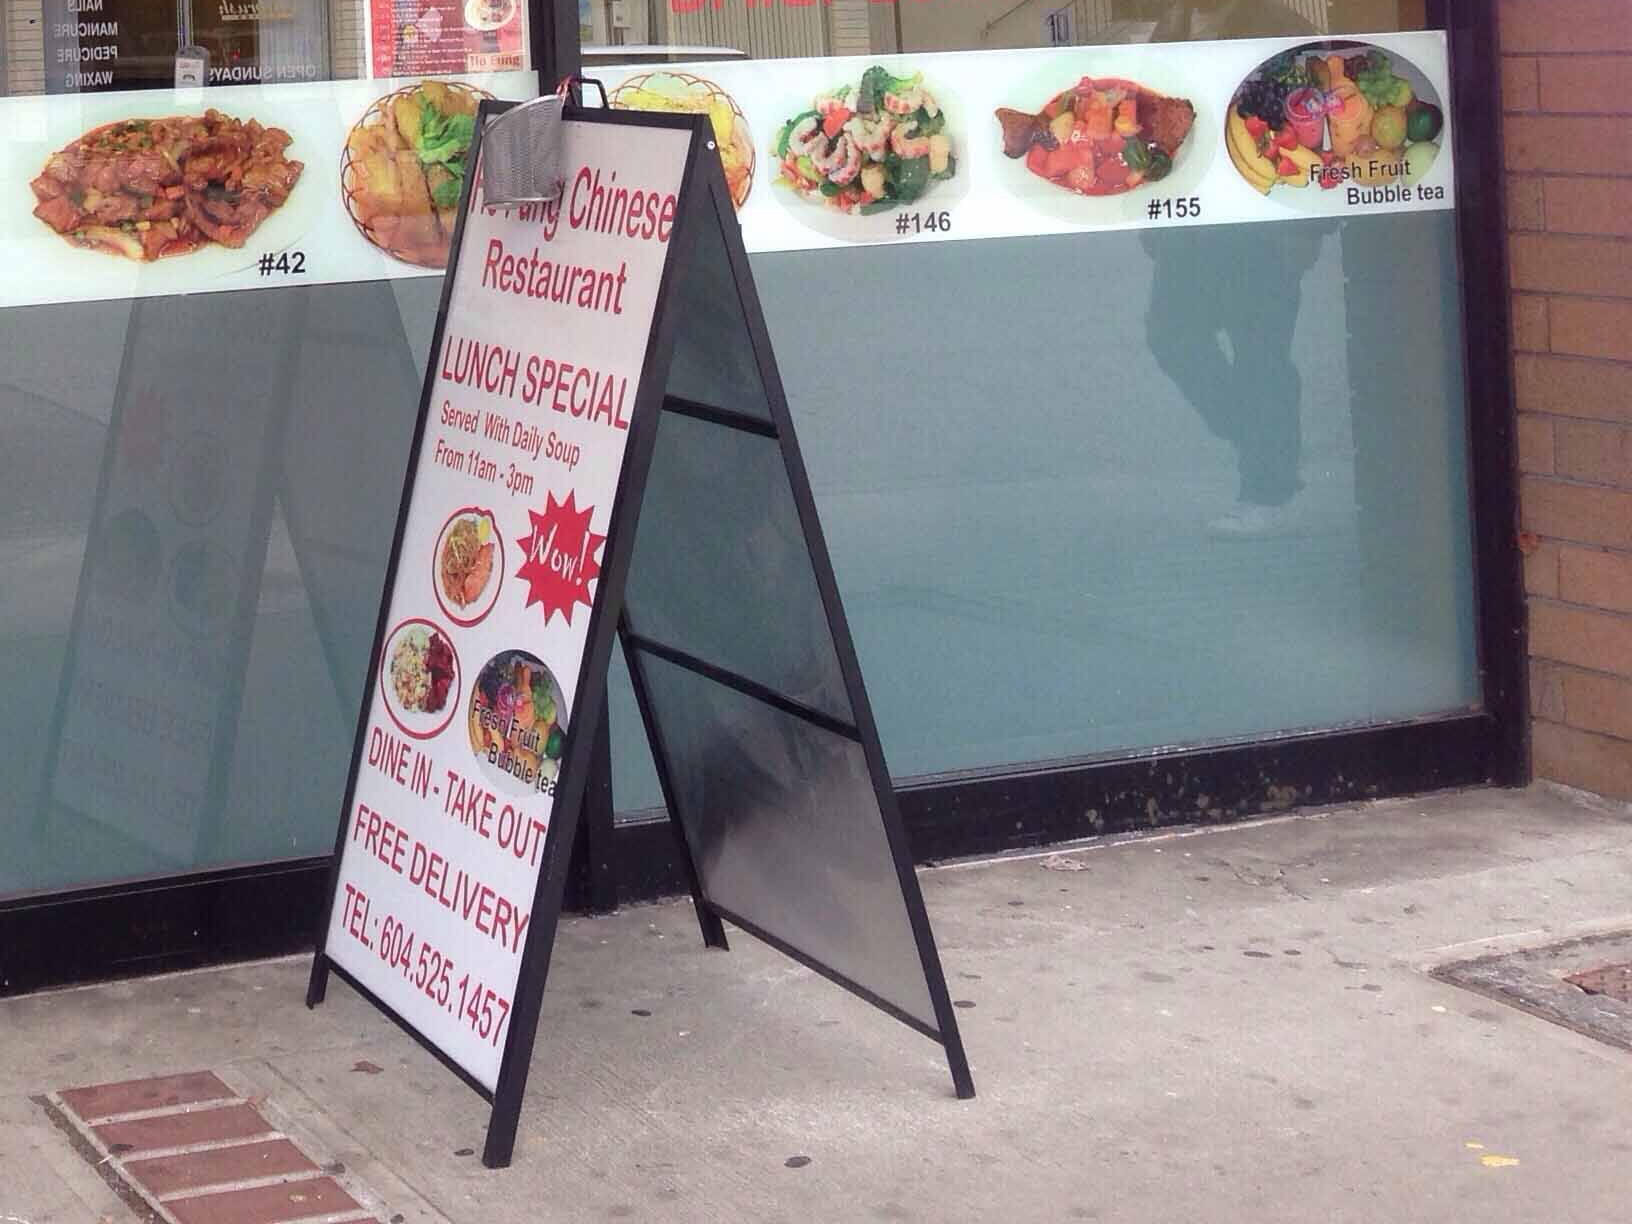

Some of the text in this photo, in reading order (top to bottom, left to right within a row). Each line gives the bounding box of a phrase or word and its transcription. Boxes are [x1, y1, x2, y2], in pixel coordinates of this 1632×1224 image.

[1310, 158, 1412, 181] Fresh Fruit
[1346, 184, 1446, 207] Bubble tea
[570, 166, 677, 243] Chinese
[895, 211, 952, 235] #146
[1147, 197, 1202, 221] #155
[258, 251, 306, 277] #42
[481, 239, 627, 314] Restaurant
[441, 335, 630, 431] LUNCH SPECIAL
[441, 399, 580, 472] Served With Daily Soup
[434, 439, 464, 473] From
[468, 450, 497, 483] 11am
[506, 462, 534, 496] 3pm
[528, 523, 590, 586] Wow!
[472, 699, 541, 753] Fresh Fruit
[368, 727, 412, 786] DINE
[410, 751, 432, 799] IN
[444, 770, 496, 839] TAKE
[497, 803, 546, 868] OUT
[487, 744, 557, 797] Bubble tea
[353, 804, 530, 954] FREE DELIVERY
[342, 882, 510, 1048] TEL: 604.525.1457
